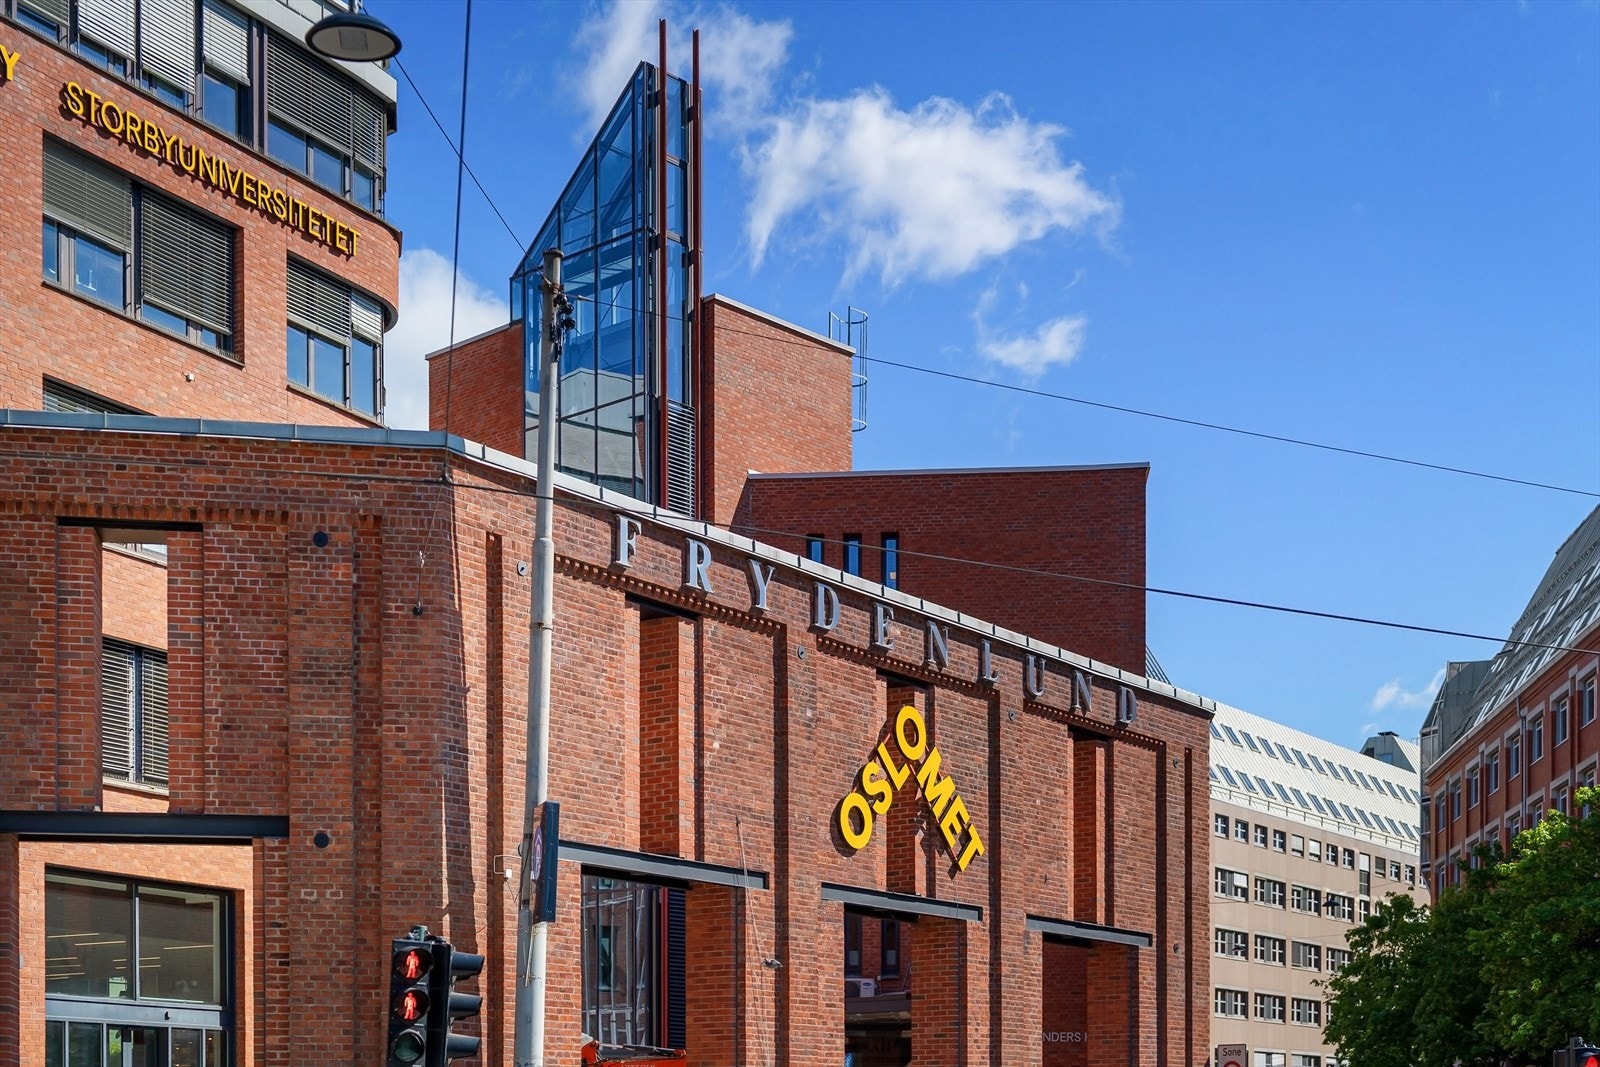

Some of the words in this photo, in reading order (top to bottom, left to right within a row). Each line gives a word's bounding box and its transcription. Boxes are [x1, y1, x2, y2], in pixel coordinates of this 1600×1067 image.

[0, 44, 20, 81] Y
[65, 81, 361, 257] STORBYUNIVERSITETET
[615, 513, 1137, 723] FRYDENLUND
[1222, 1047, 1242, 1057] Sone
